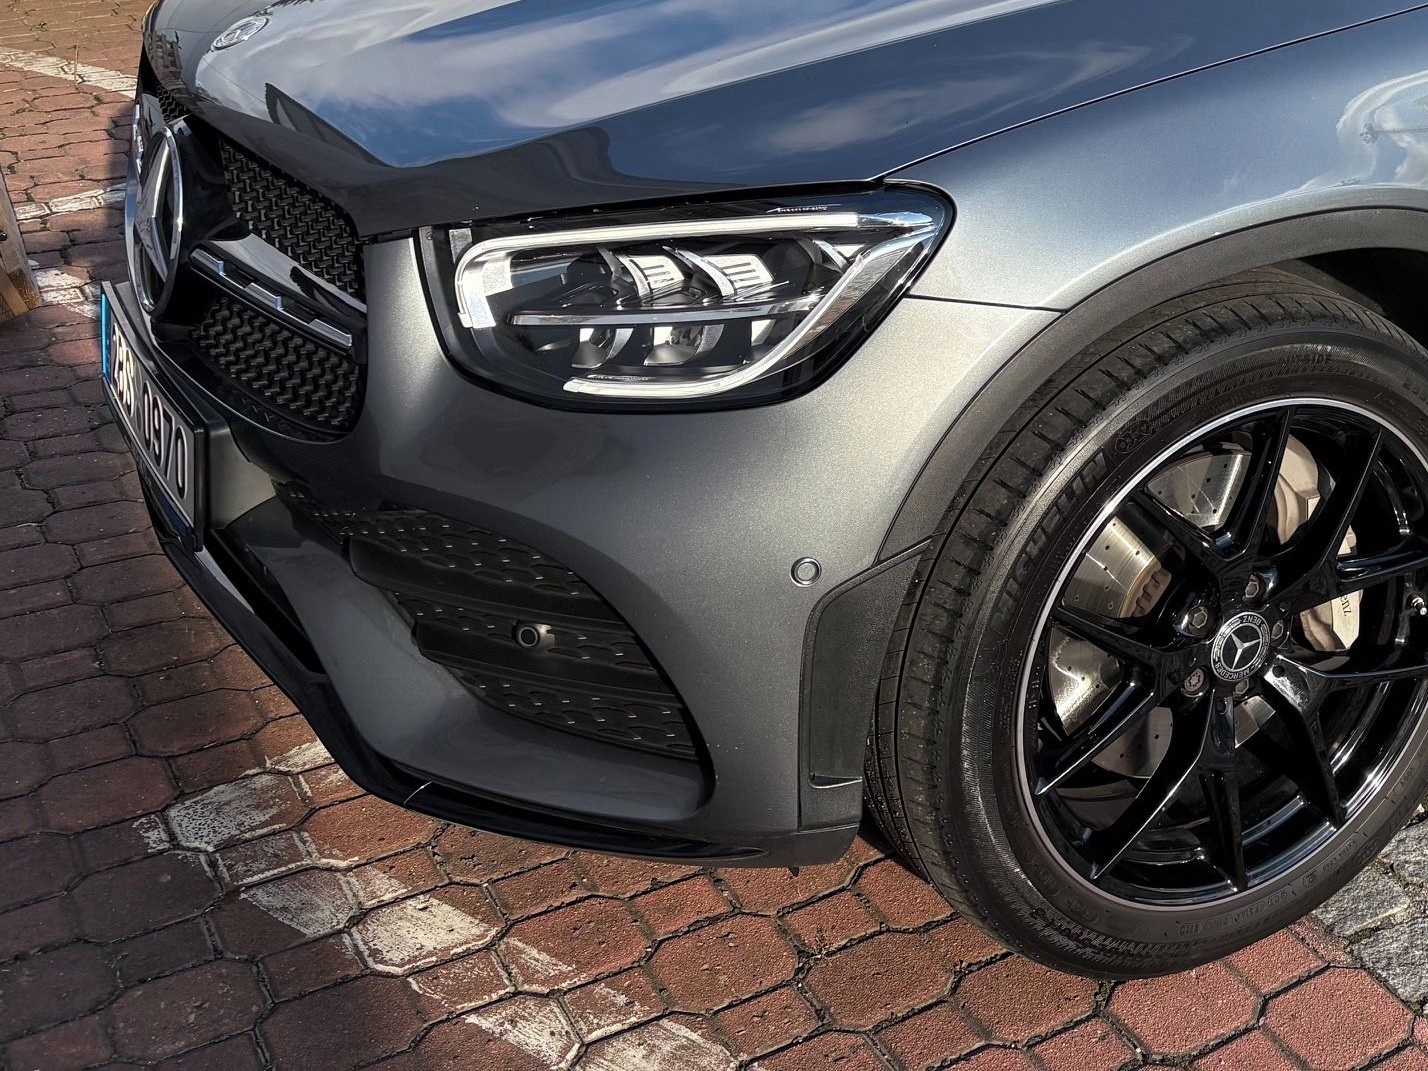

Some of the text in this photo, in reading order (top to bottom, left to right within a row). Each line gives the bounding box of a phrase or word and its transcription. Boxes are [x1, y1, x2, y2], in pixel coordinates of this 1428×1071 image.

[143, 380, 188, 500] 0970
[992, 450, 1107, 628] MICHELIN
[1242, 615, 1262, 626] BENZ
[1215, 661, 1250, 680] MERCEDES
